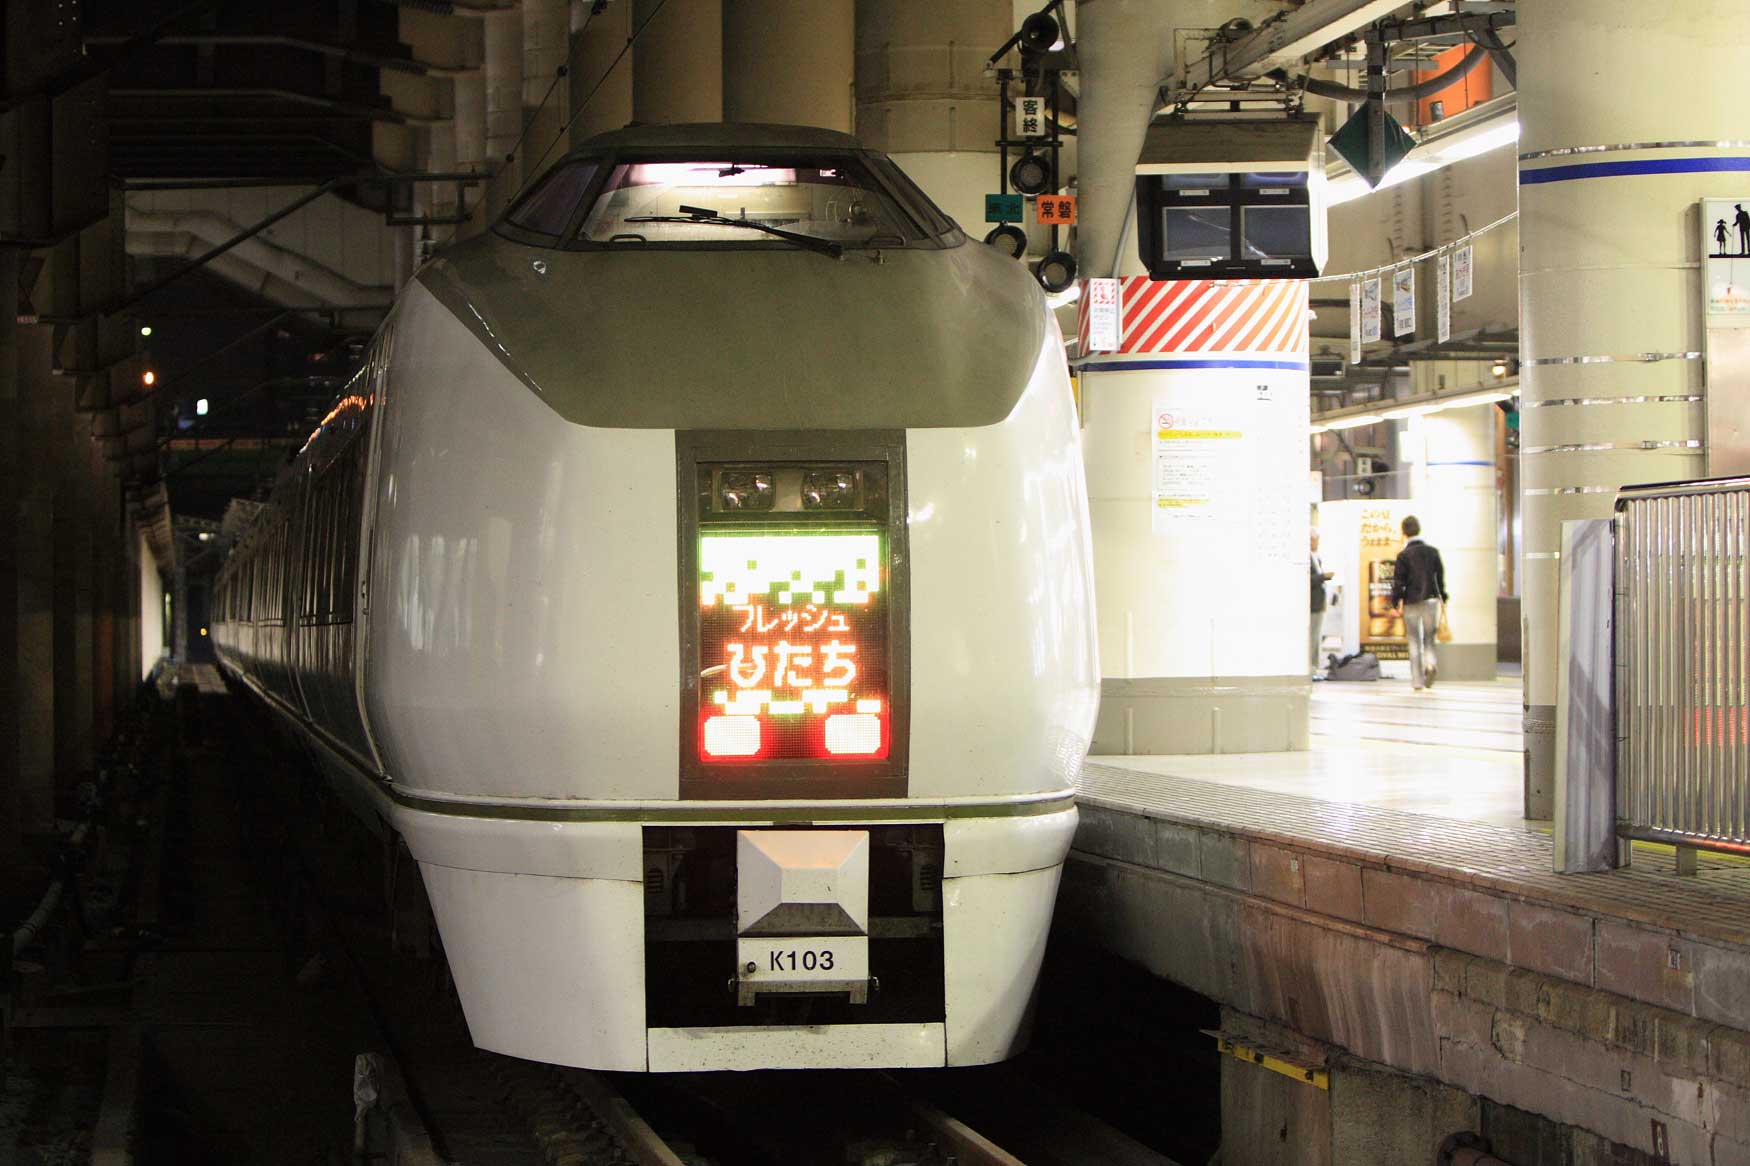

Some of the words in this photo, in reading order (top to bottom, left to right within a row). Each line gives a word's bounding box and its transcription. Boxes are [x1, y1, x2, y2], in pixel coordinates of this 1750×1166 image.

[1041, 200, 1072, 219] 常磐
[732, 603, 850, 632] フレッシュ
[727, 640, 857, 688] ひたち
[770, 950, 834, 971] K103
